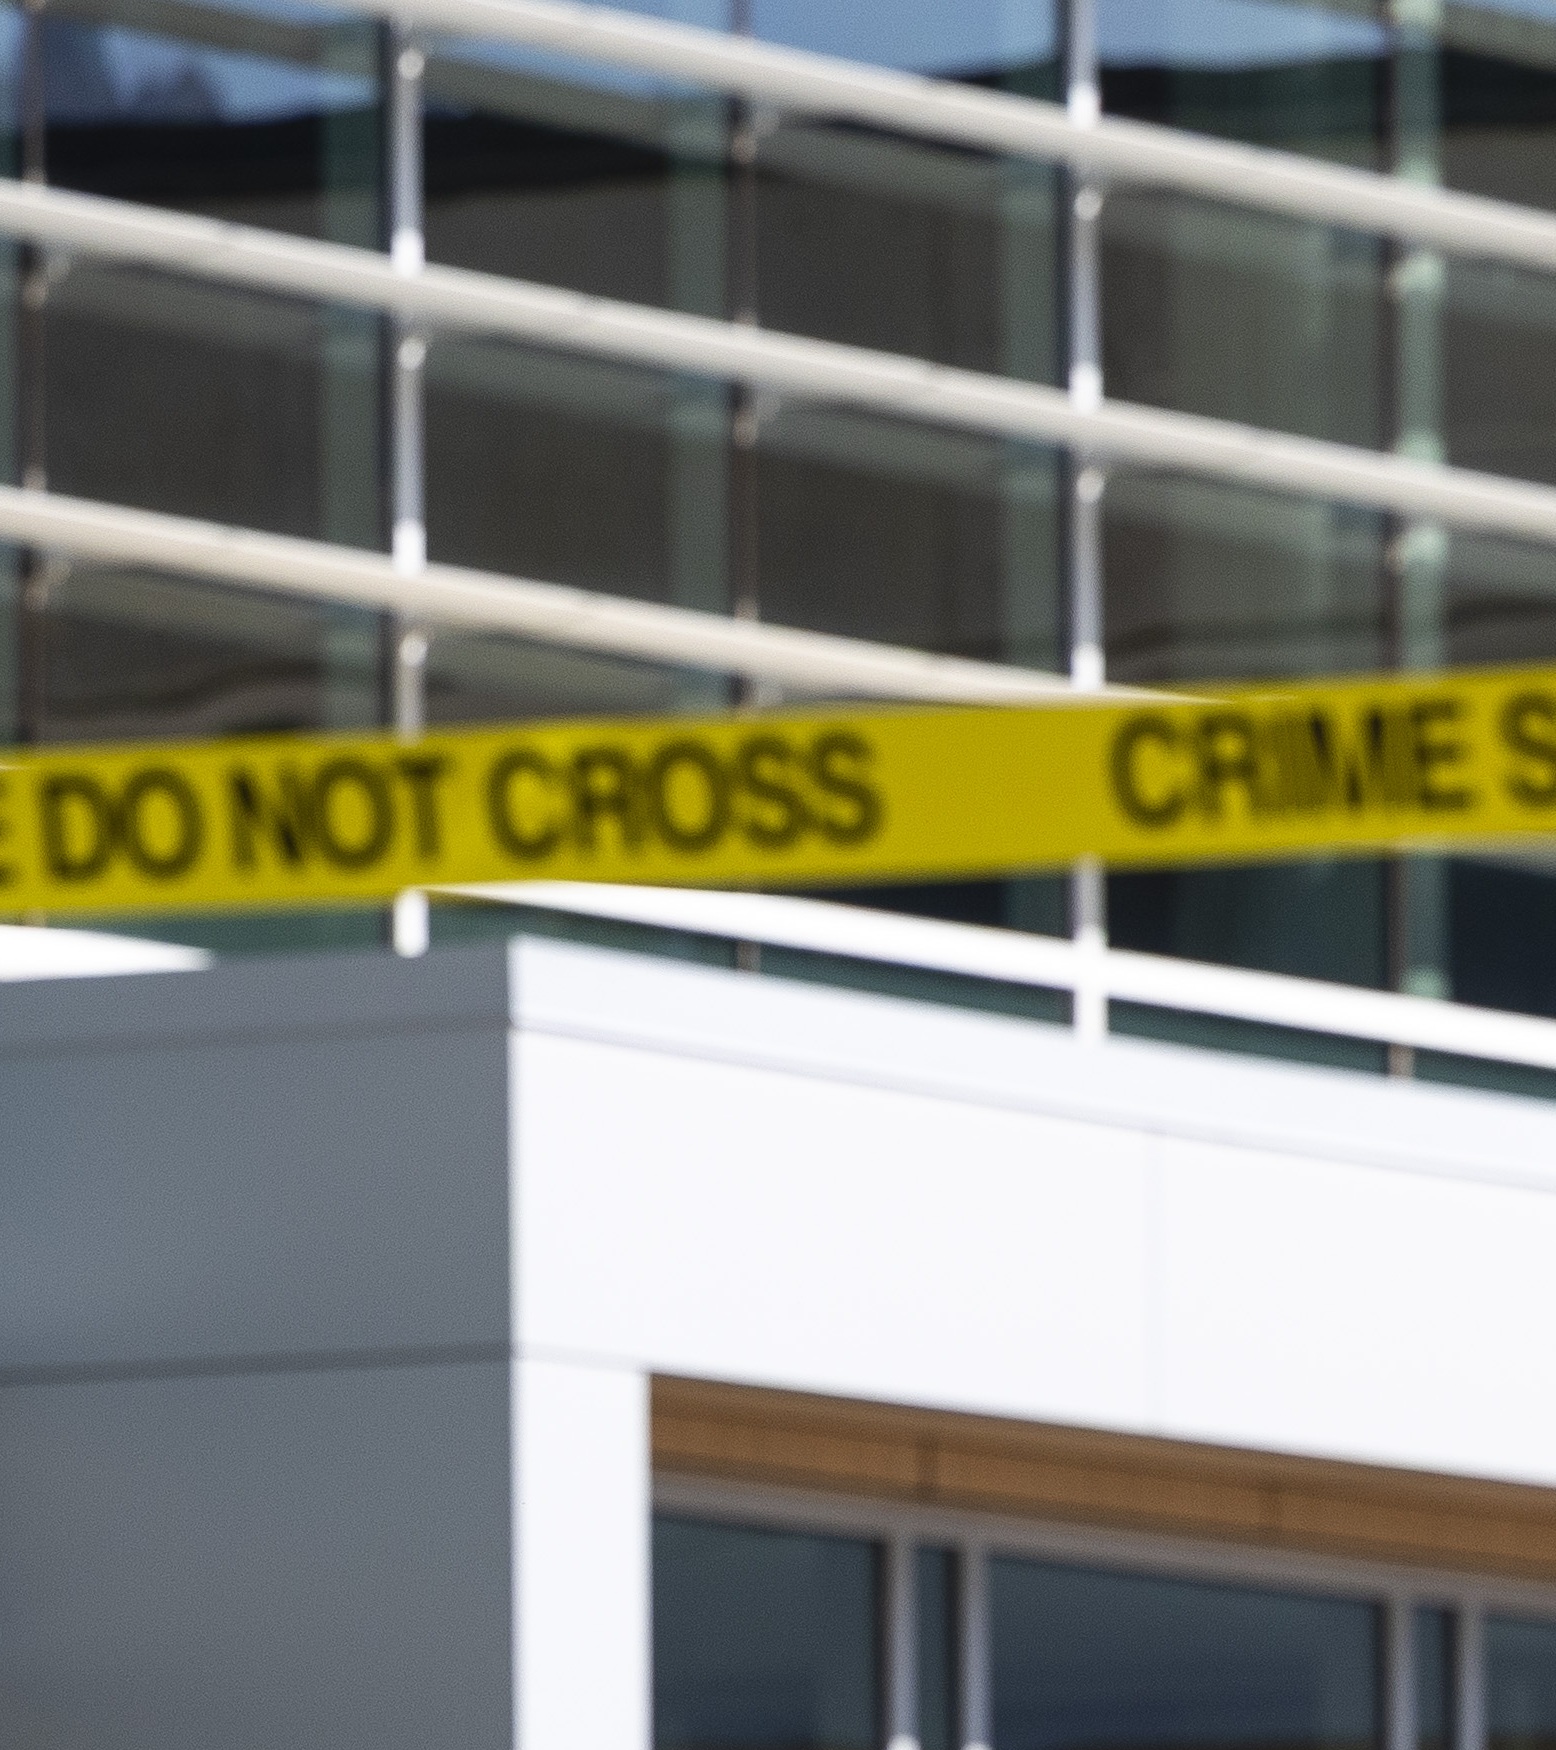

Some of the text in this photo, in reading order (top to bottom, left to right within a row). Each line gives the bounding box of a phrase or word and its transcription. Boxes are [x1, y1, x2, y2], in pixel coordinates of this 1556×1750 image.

[41, 767, 206, 880] DO
[228, 756, 454, 873] NOT
[487, 732, 883, 859] CROSS
[1109, 700, 1478, 829] CRIME
